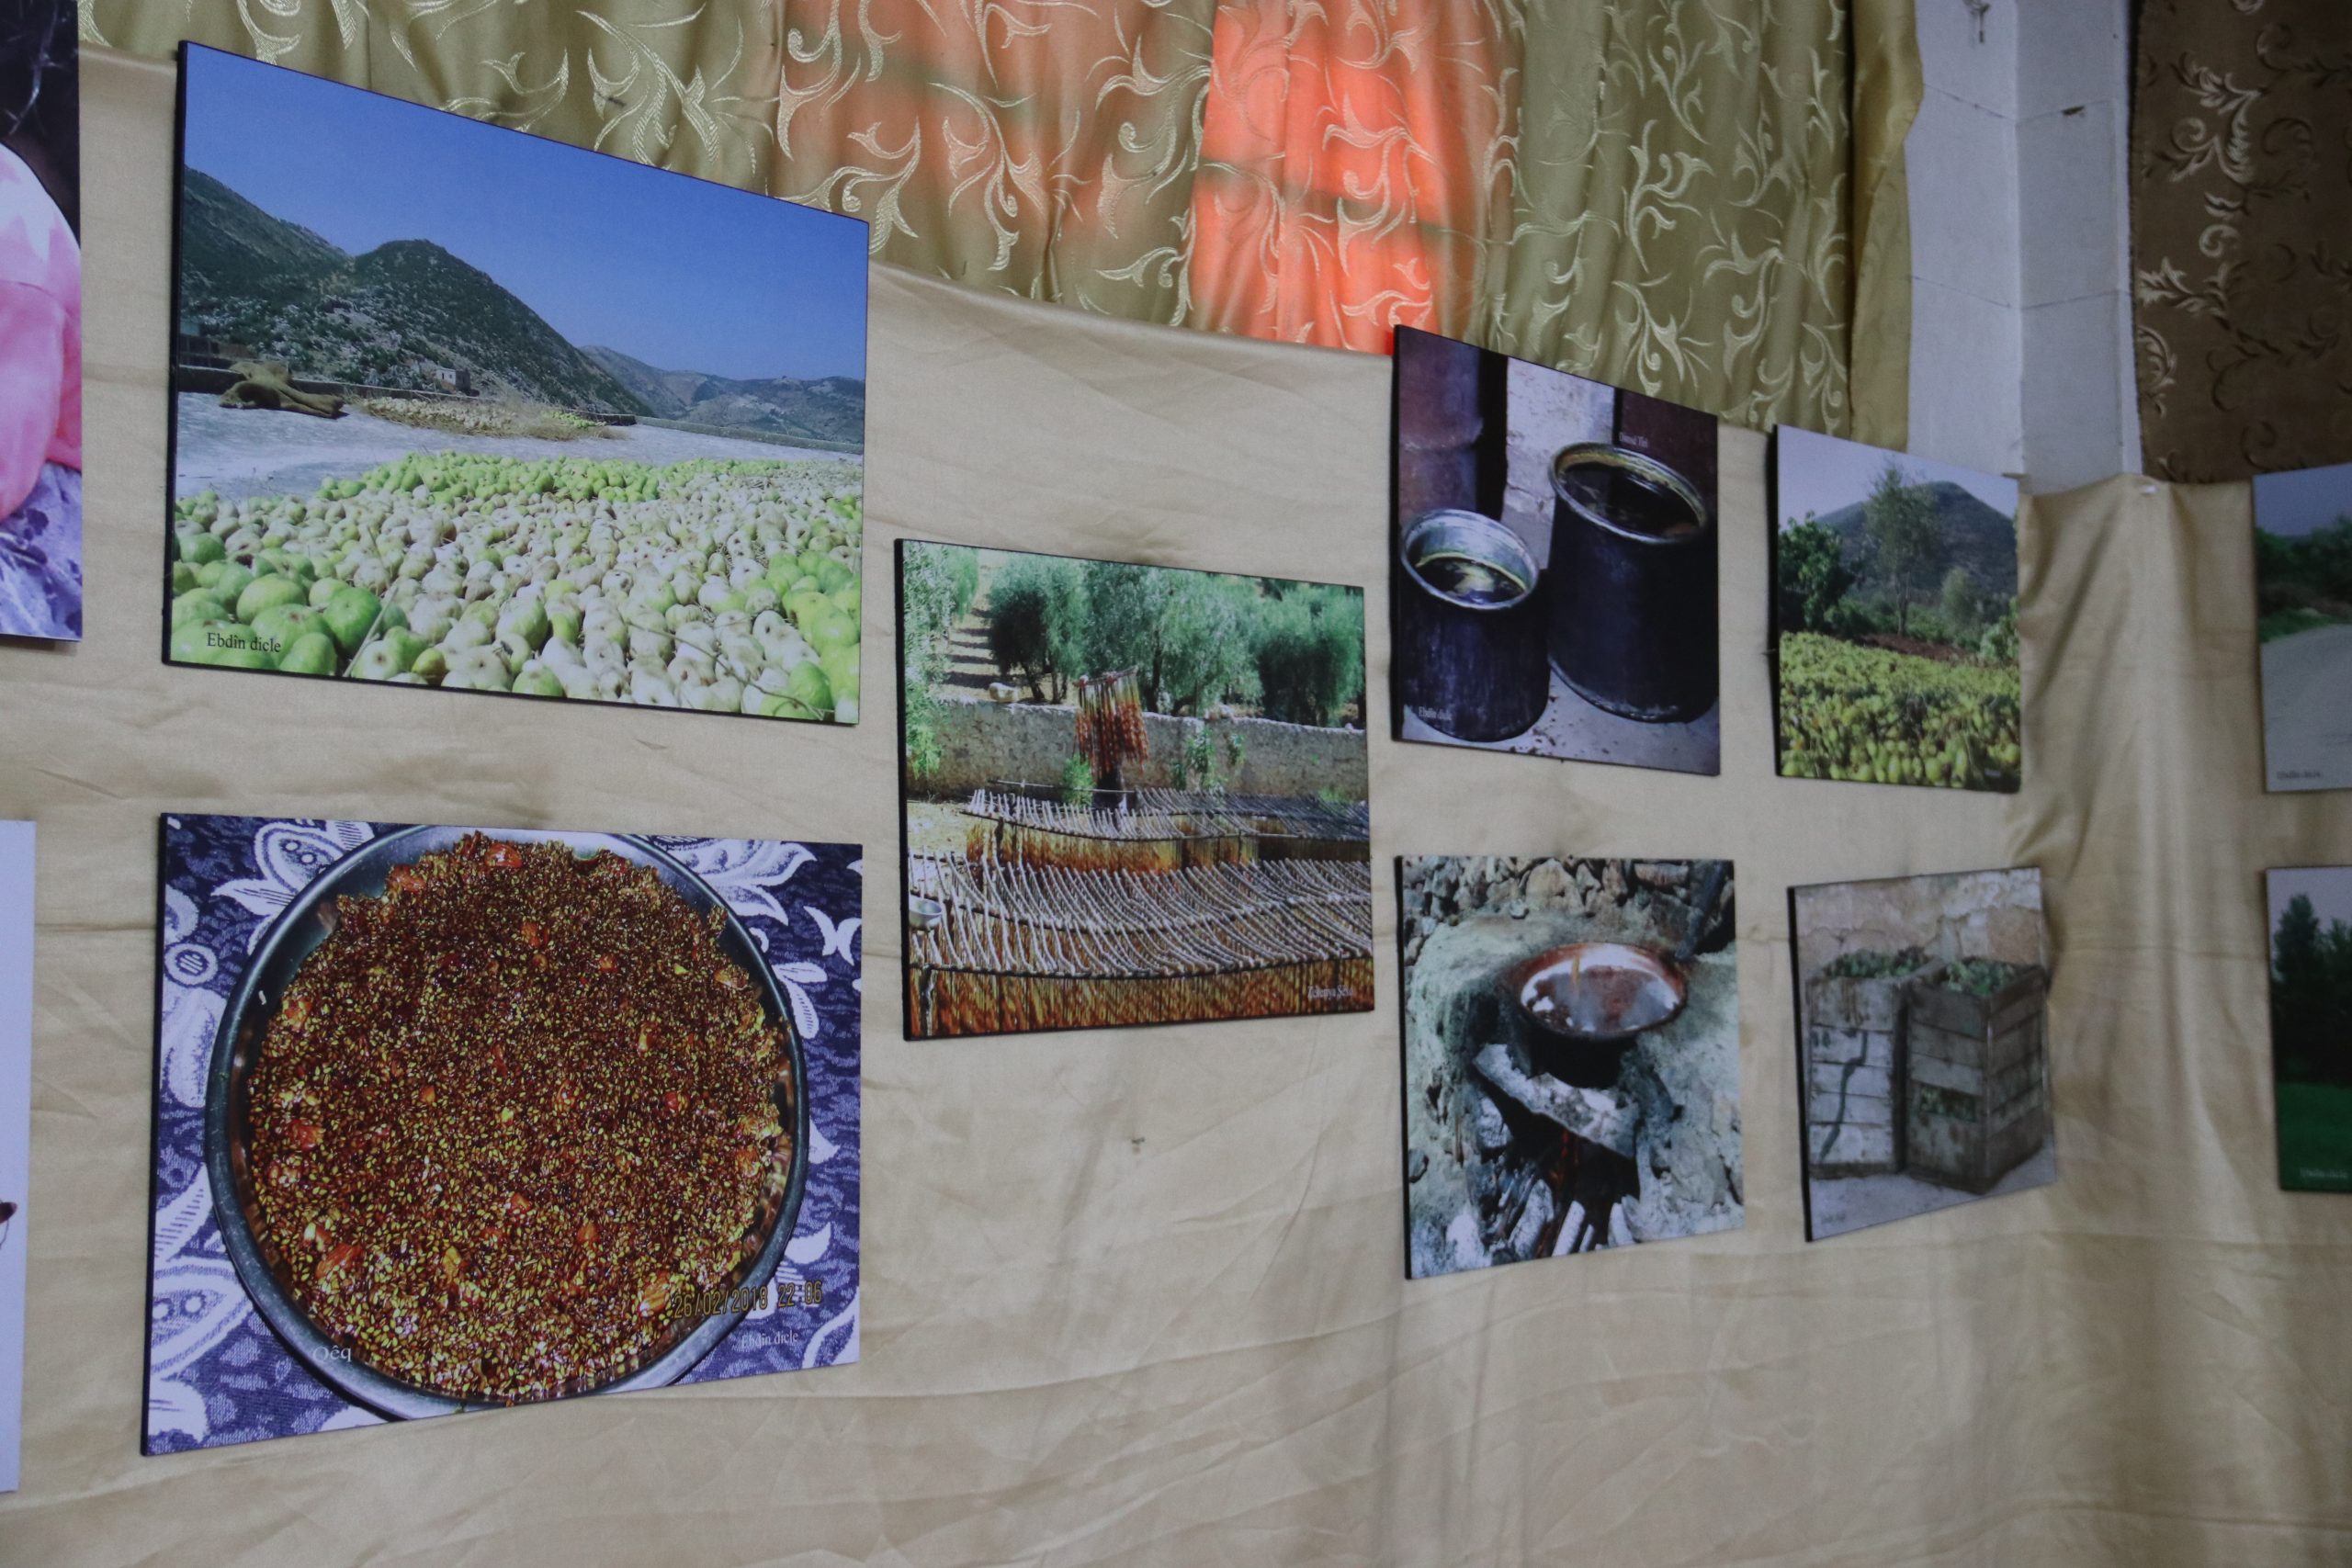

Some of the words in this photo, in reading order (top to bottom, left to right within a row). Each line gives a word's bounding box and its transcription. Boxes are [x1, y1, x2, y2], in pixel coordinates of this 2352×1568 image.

[207, 631, 245, 650] Ebdîn
[250, 636, 281, 653] dicle
[673, 1286, 768, 1320] 26/02/2018
[777, 1280, 823, 1308] 22:06
[774, 1329, 798, 1345] dicle
